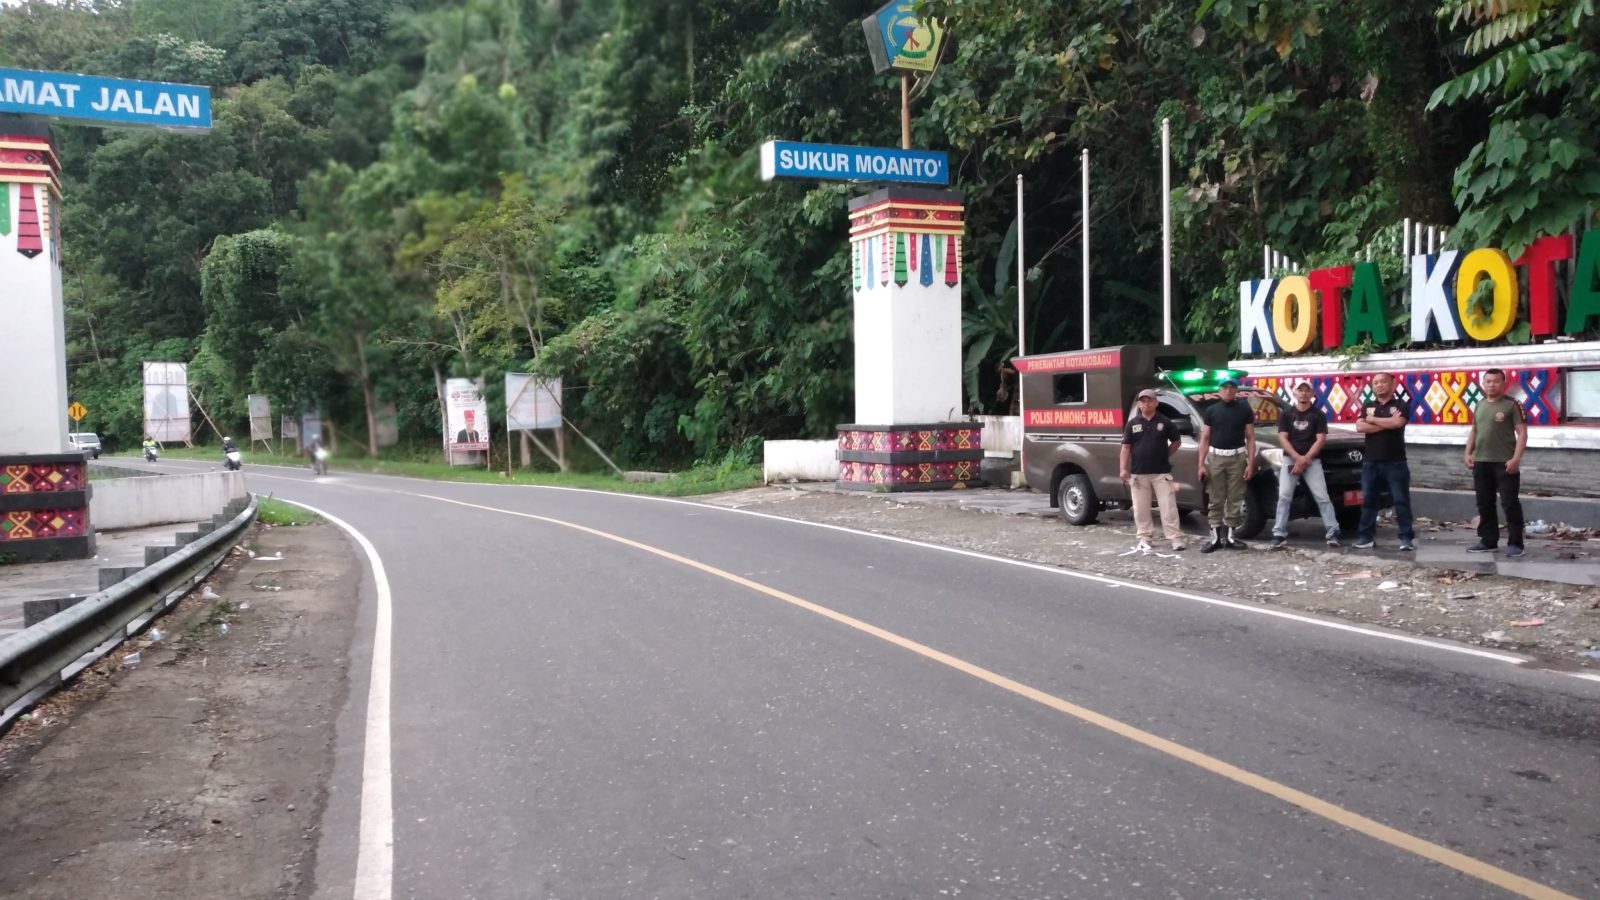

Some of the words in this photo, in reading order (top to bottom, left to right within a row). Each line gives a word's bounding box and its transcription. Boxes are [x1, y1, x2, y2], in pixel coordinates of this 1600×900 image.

[0, 78, 80, 108] MAT
[91, 87, 200, 118] JALAN
[780, 150, 849, 172] SUKUR
[856, 154, 942, 177] MOANTO'
[1240, 262, 1393, 354] KOTA
[1027, 358, 1065, 371] PEMERINTAH
[1066, 354, 1112, 368] KOTAMOBAGU
[1030, 411, 1053, 425] POLISI
[1054, 411, 1086, 425] PAMONG
[1088, 411, 1115, 425] PRAJA
